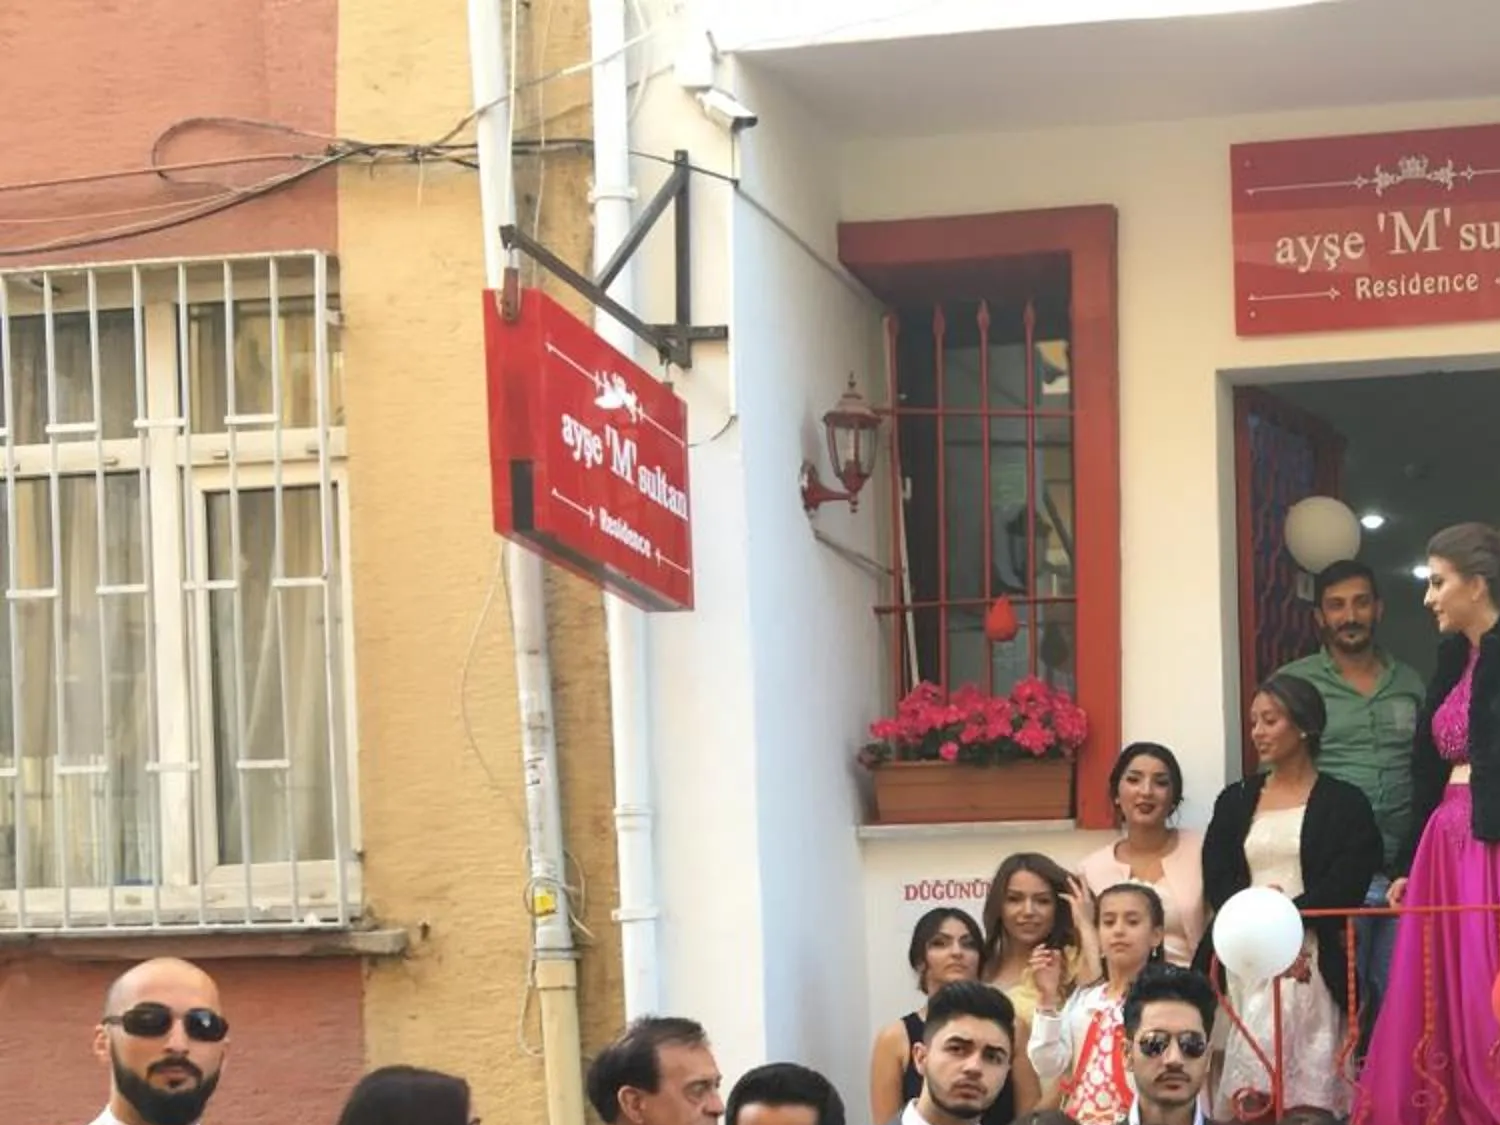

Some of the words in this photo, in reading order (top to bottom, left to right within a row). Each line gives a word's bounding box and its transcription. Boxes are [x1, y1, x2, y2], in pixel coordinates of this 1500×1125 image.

[1275, 232, 1365, 273] ayşe
[1355, 272, 1480, 300] Residence
[561, 413, 604, 469] ayşe
[599, 507, 652, 557] Residence
